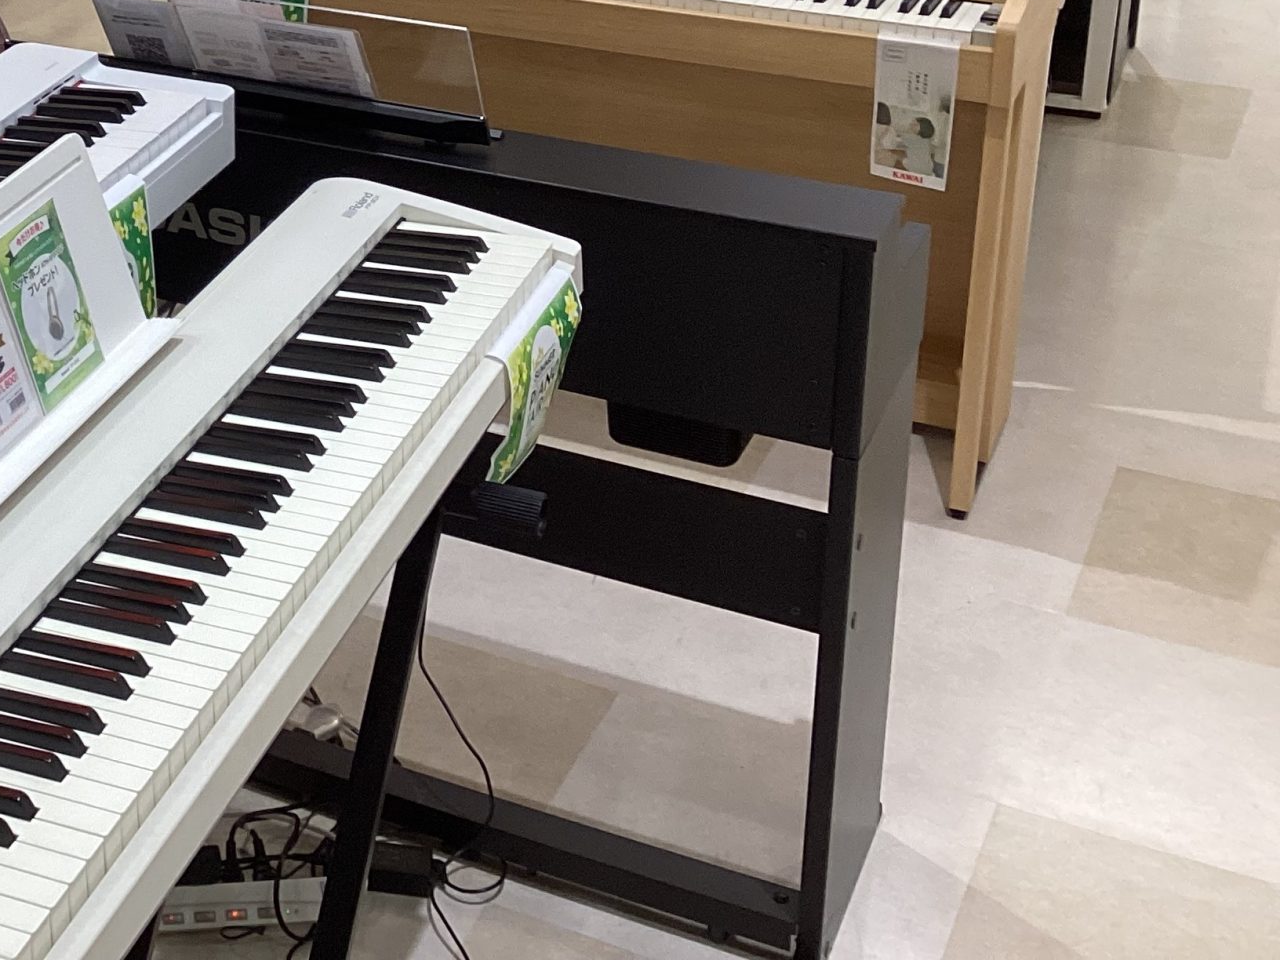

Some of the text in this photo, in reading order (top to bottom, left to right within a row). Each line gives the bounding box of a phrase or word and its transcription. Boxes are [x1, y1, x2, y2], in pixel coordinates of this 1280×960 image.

[892, 171, 924, 184] KAWAI
[349, 191, 374, 210] Roland
[166, 202, 261, 245] ASI
[12, 262, 42, 291] ヘッドホン
